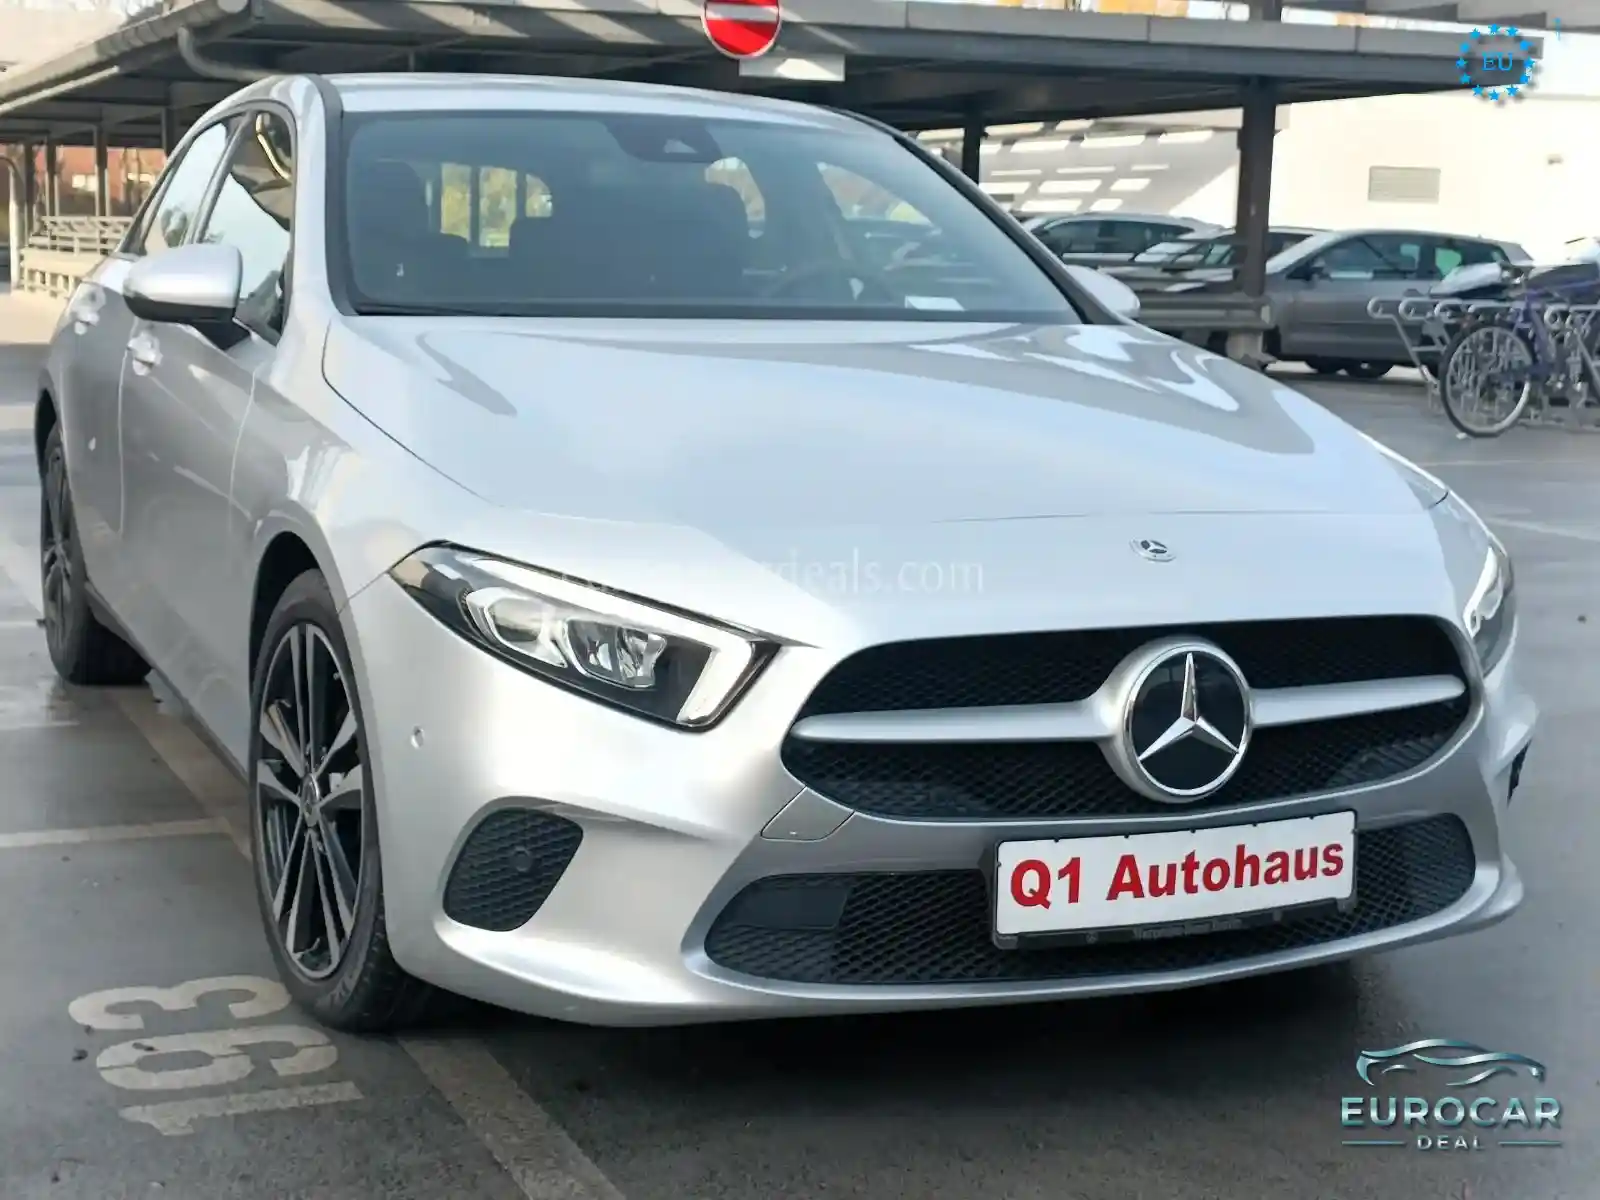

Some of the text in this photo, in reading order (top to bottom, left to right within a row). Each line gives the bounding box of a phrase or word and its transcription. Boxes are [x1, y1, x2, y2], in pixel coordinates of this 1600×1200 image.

[1010, 844, 1344, 909] Q1 Autohaus
[68, 975, 364, 1136] 193
